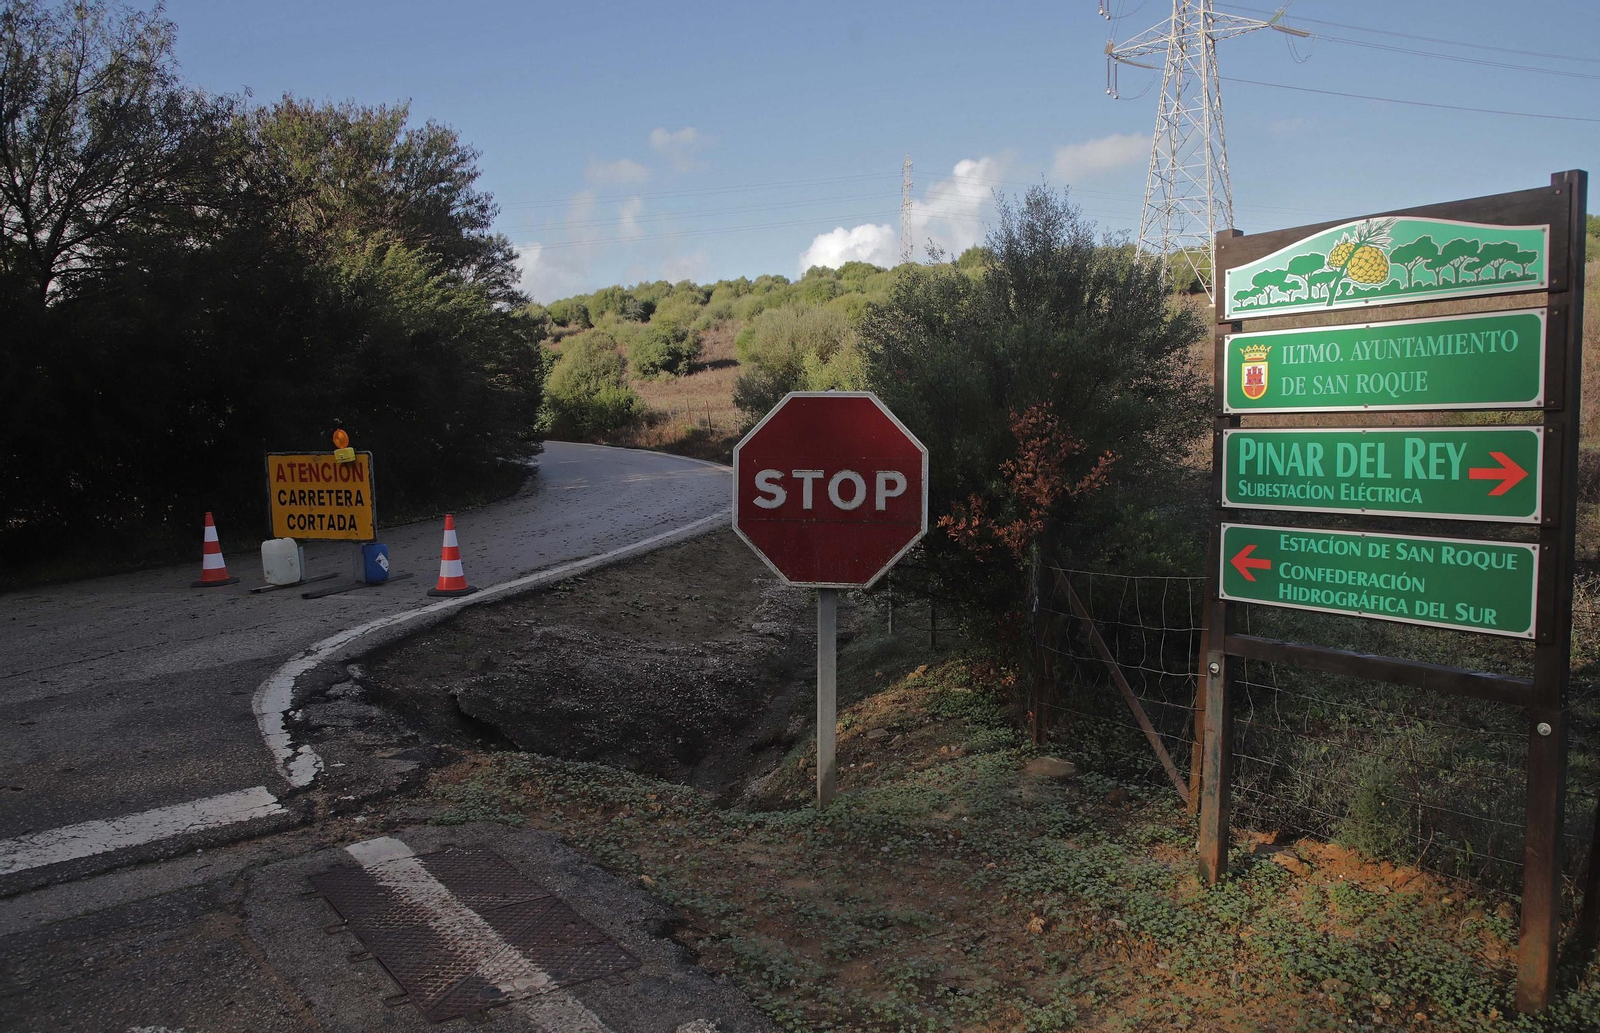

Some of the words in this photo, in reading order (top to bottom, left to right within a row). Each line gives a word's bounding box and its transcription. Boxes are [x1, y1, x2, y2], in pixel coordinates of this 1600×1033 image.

[1281, 342, 1344, 365] ILTMO.
[1350, 329, 1519, 362] AYUNTAMIENTO
[1281, 376, 1306, 397] DE
[1312, 374, 1349, 395] SAN
[1356, 371, 1428, 398] ROQUE
[276, 462, 364, 483] ATENCION
[1238, 437, 1324, 477] PINAR
[1336, 442, 1391, 479] DEL
[1404, 437, 1467, 480] REY
[278, 489, 364, 507] CARRETERA
[753, 469, 908, 511] STOP
[1340, 482, 1423, 504] ELÉCTRICA
[287, 514, 357, 531] CORTADA
[1368, 543, 1390, 559] DE
[1396, 538, 1434, 563] SAN
[1442, 546, 1518, 571] ROQUE
[1279, 562, 1425, 593] CONFEDERACIÓN
[1278, 583, 1408, 614] HIDROGRÁFICA
[1415, 600, 1449, 619] DEL
[1455, 602, 1497, 625] SUR
